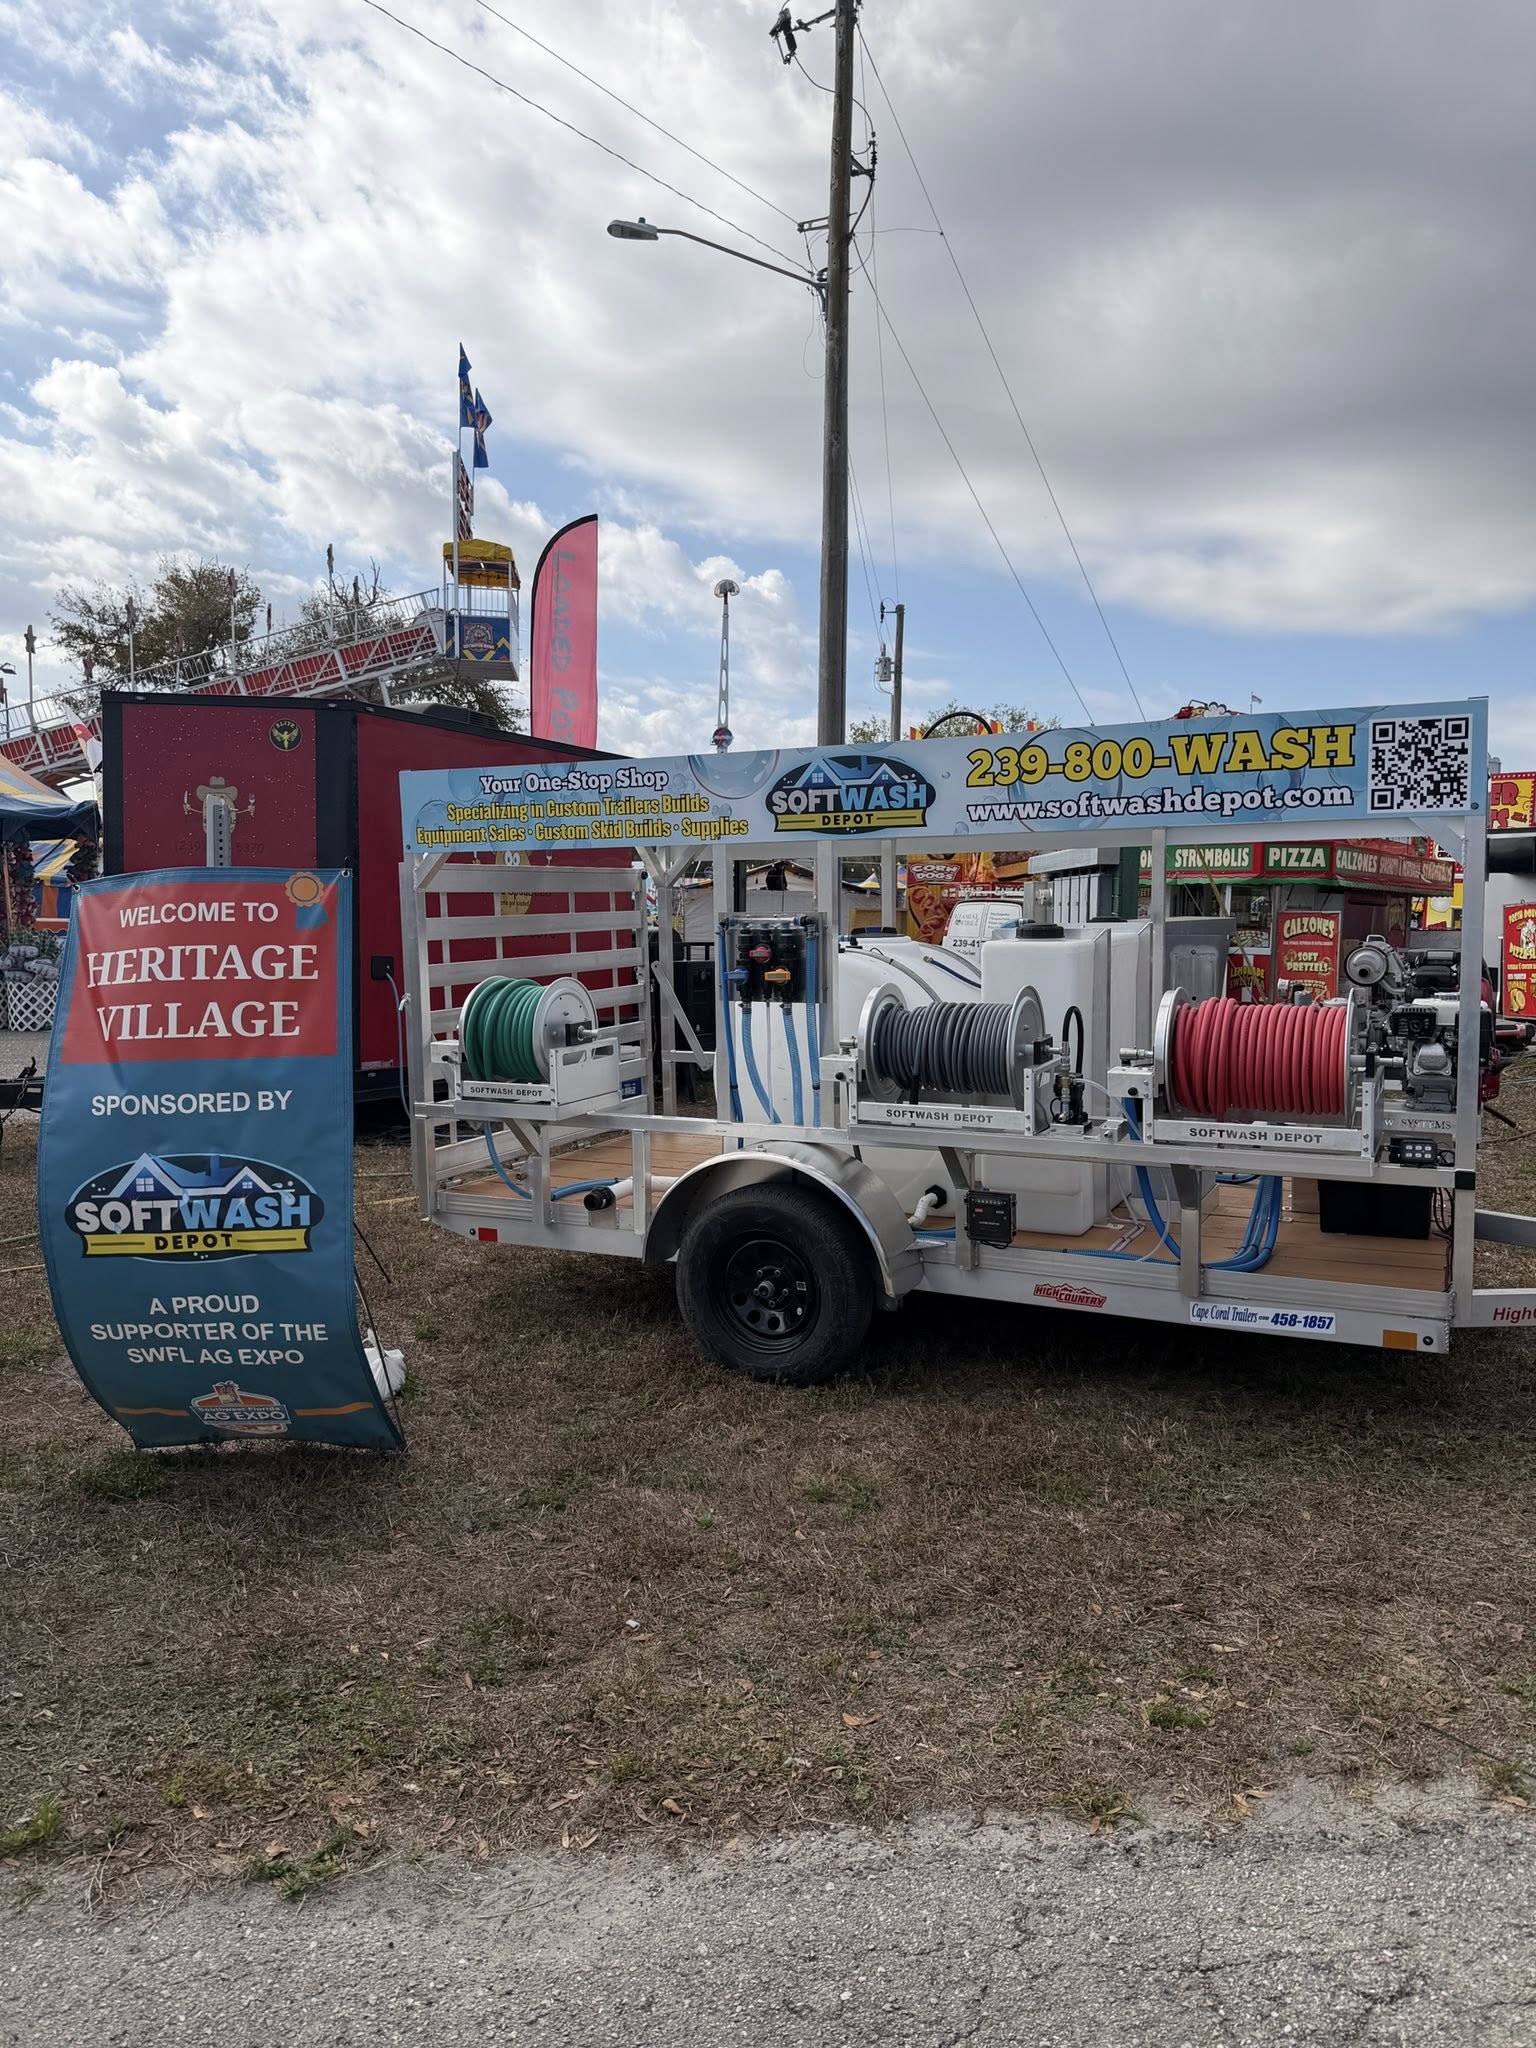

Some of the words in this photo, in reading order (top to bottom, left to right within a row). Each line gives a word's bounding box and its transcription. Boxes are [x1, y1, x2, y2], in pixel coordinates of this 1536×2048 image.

[551, 549, 577, 673] LOADED
[966, 724, 1356, 787] 239-800-WASH
[480, 776, 522, 794] Your
[525, 771, 612, 792] One-Stop
[615, 767, 669, 790] Shop
[447, 802, 528, 825] Specializing
[531, 803, 544, 819] in
[546, 800, 600, 818] Custom
[602, 796, 659, 816] Trailers
[662, 793, 709, 813] Builds
[772, 784, 927, 814] SOFTWASH
[966, 786, 1353, 822] www.softwashdepot.com
[822, 814, 874, 826] DEPOT
[416, 827, 486, 847] Equipment
[488, 824, 525, 842] Sales
[535, 822, 589, 841] Custom
[591, 820, 623, 839] Skid
[626, 819, 671, 838] Builds
[682, 817, 748, 841] Supplies
[912, 864, 958, 872] CORN
[1175, 848, 1250, 868] STROMBOLIS
[1268, 848, 1326, 868] PIZZA
[1336, 849, 1377, 873] CALZONES
[120, 902, 236, 928] WELCOME
[243, 902, 278, 922] TO
[1283, 917, 1334, 939] CALZONES
[953, 939, 986, 947] 239-41
[87, 945, 319, 988] HERITAGE
[1286, 961, 1328, 972] PRETZELS
[1298, 952, 1318, 961] SOFT
[97, 1001, 300, 1042] VILLAGE
[470, 1086, 513, 1096] SOFTWASH
[516, 1088, 542, 1097] DEPOT
[91, 1092, 250, 1116] SPONSORED
[257, 1090, 292, 1111] BY
[886, 1109, 949, 1121] SOFTWASH
[954, 1113, 993, 1123] DEPOT
[1401, 1119, 1451, 1130] SYSTEMS
[1189, 1128, 1267, 1140] SOFTWASH
[1275, 1133, 1323, 1144] DEPOT
[75, 1195, 310, 1233] SOFTWASH
[154, 1233, 232, 1250] DEPOT
[150, 1298, 168, 1315] A
[172, 1295, 259, 1315] PROUD
[1192, 1304, 1209, 1318] Cape
[1210, 1305, 1230, 1320] Coral
[1231, 1306, 1258, 1323] Trailers
[1270, 1312, 1334, 1330] 458-1857
[90, 1323, 237, 1341] SUPPORTER
[242, 1323, 273, 1341] OF
[280, 1324, 328, 1341] THE
[127, 1347, 194, 1364] SWFL
[200, 1349, 232, 1364] AG
[239, 1349, 304, 1365] EXPO
[204, 1412, 230, 1421] AG
[236, 1411, 285, 1420] EXPO
